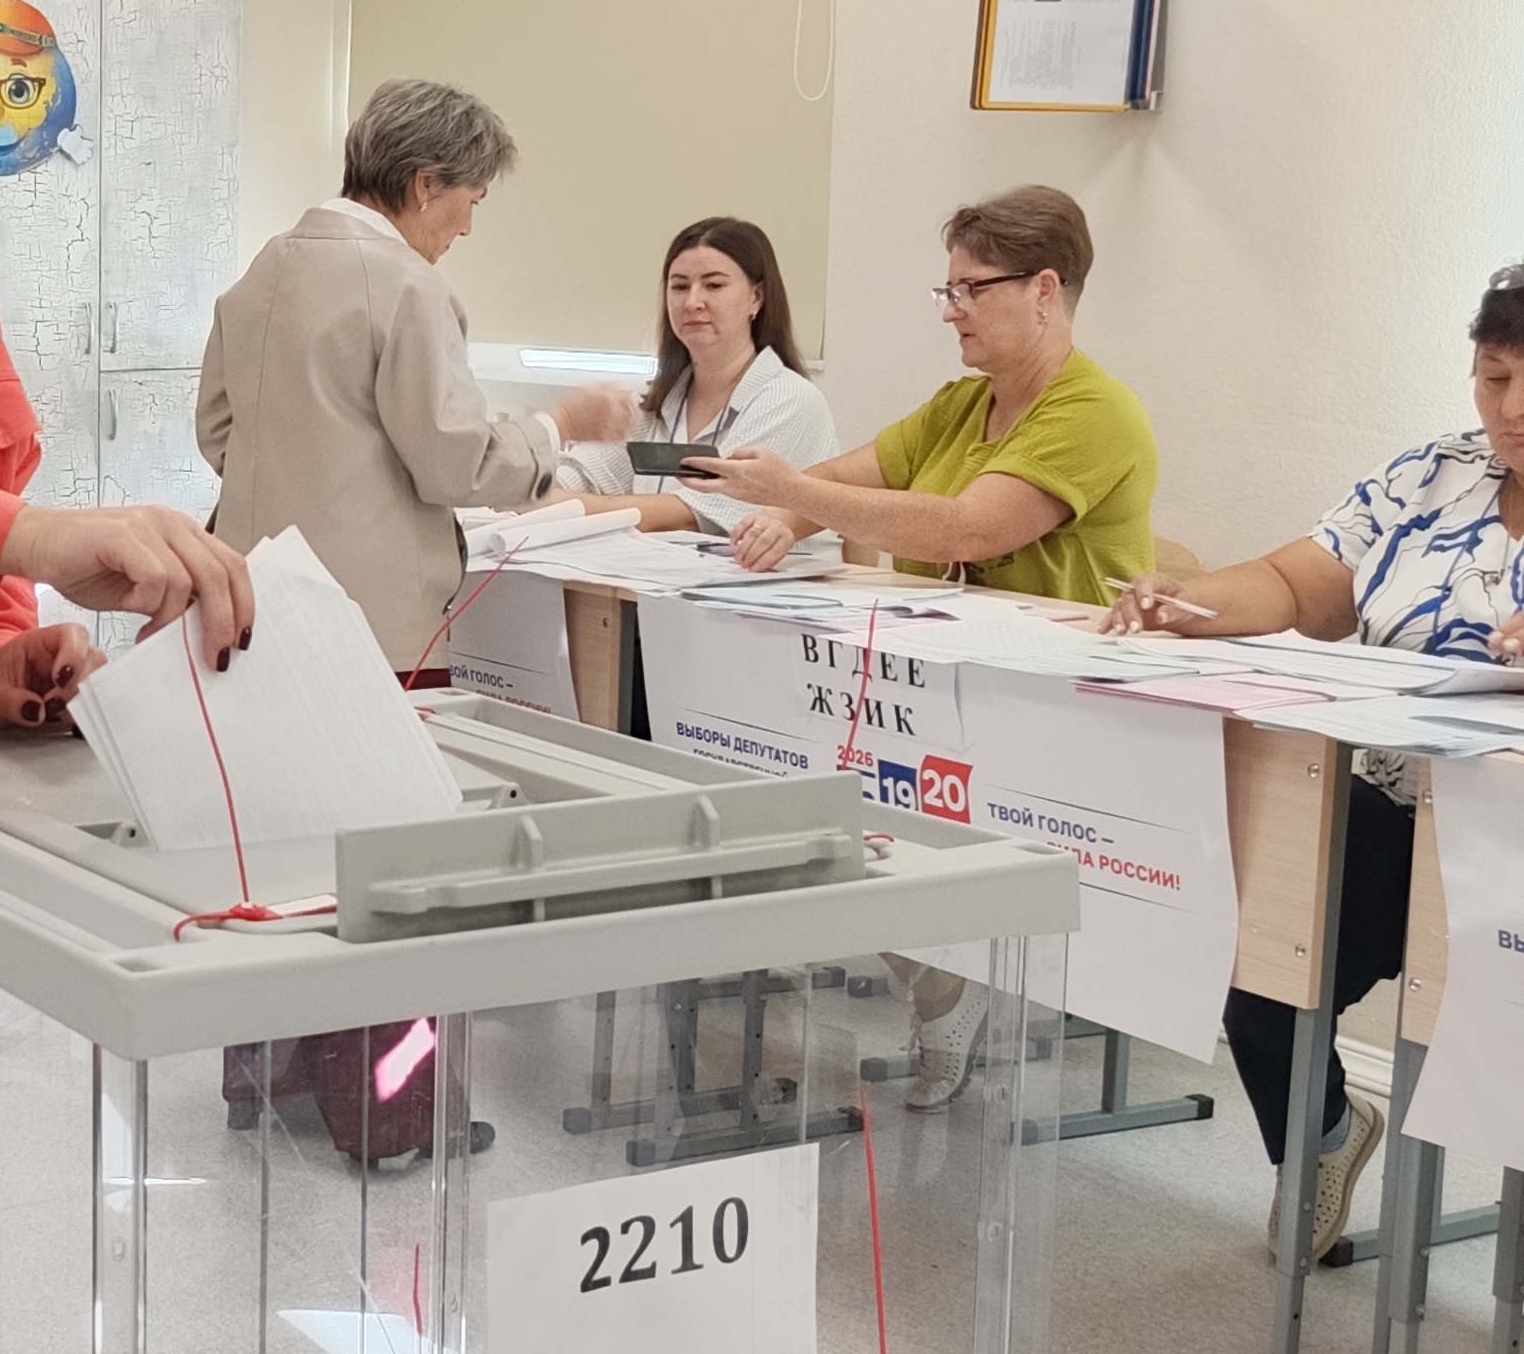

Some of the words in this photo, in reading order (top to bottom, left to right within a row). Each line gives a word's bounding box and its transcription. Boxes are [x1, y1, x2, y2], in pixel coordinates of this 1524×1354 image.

[470, 670, 504, 688] ГОЛОС
[676, 722, 730, 747] ВЫБОРЫ
[734, 737, 809, 770] ДЕПУТАТОВ
[837, 745, 874, 767] 2026
[882, 776, 916, 811] 19
[923, 769, 966, 813] 20
[987, 802, 1034, 827] ТВОЙ
[1038, 814, 1097, 843] ГОЛОС
[1099, 854, 1181, 891] РОССИИ!
[580, 1196, 749, 1293] 2210
